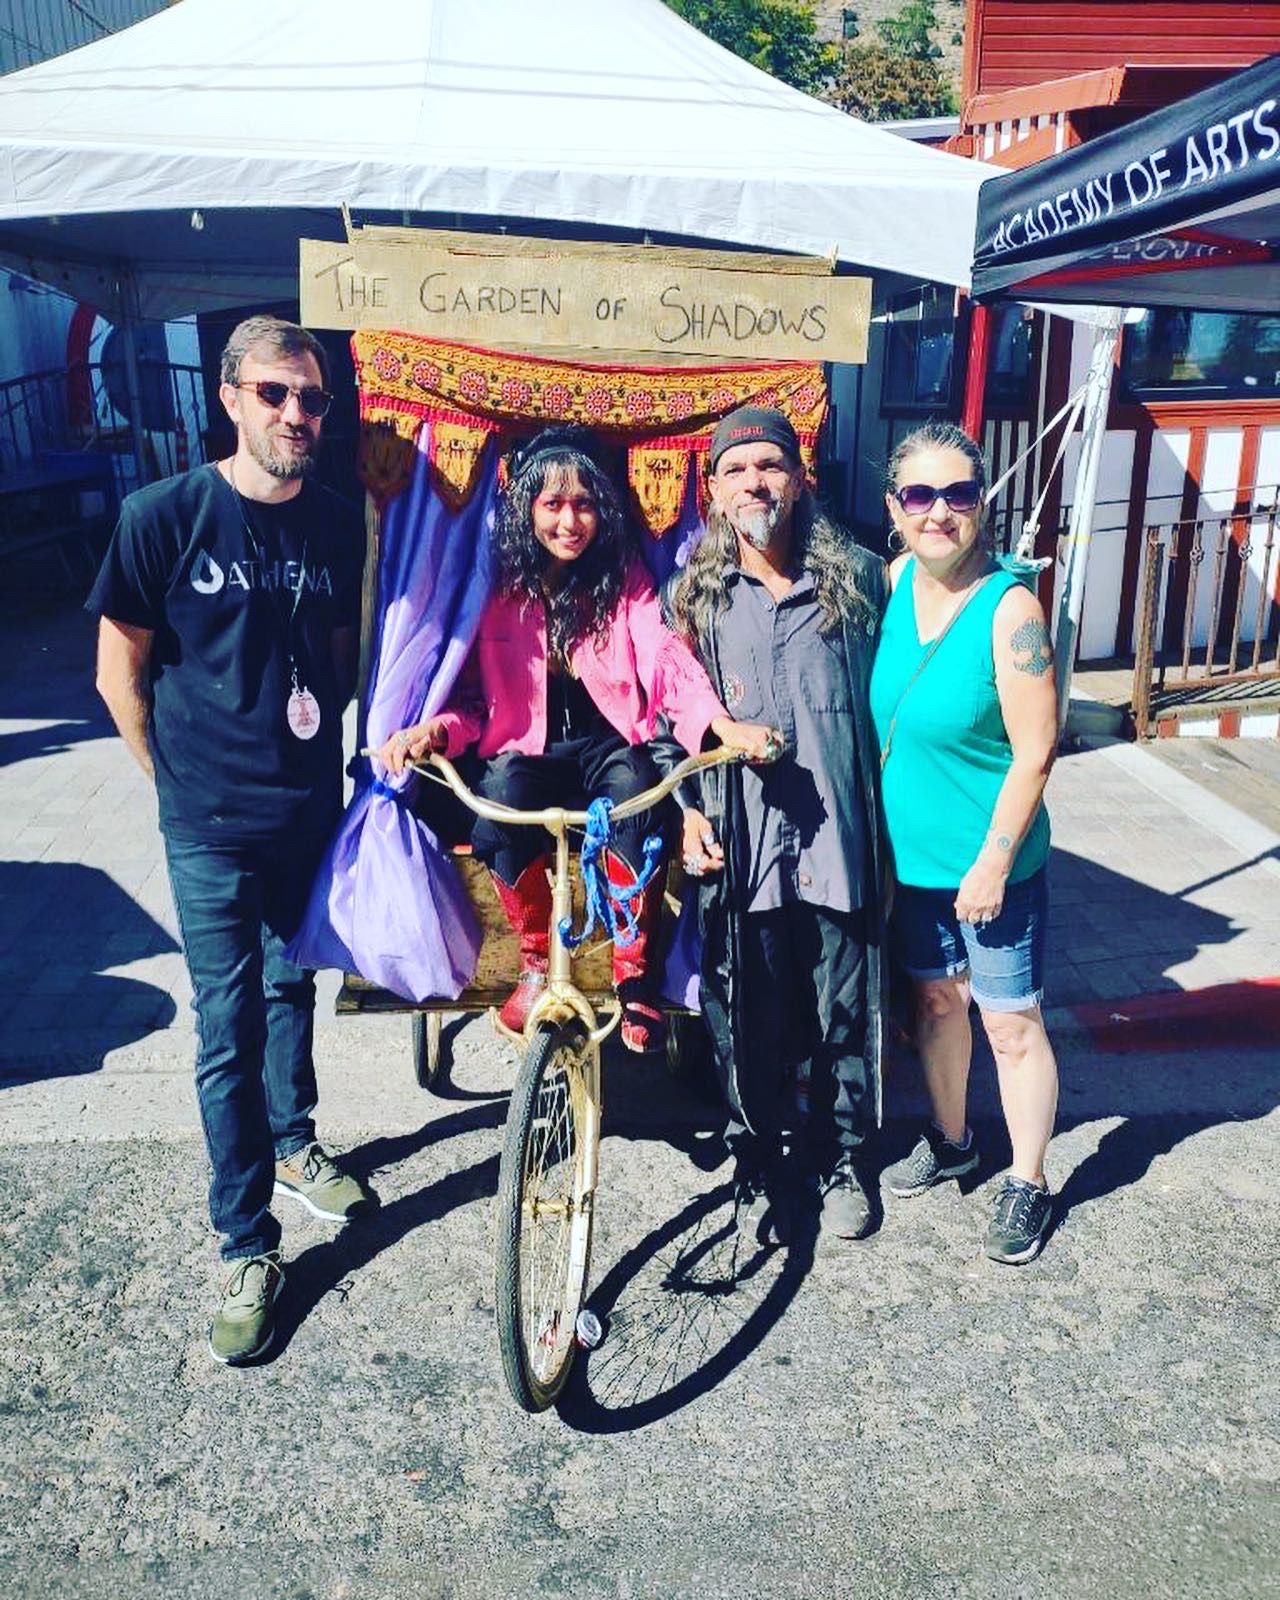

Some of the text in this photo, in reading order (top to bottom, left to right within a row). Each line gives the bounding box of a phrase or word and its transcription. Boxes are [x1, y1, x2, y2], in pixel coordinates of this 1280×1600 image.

[992, 172, 1113, 254] ACADEMY
[1124, 149, 1171, 206] OF
[315, 256, 827, 343] THE GARDEN OF SHADOWS
[227, 560, 333, 597] ATHENA
